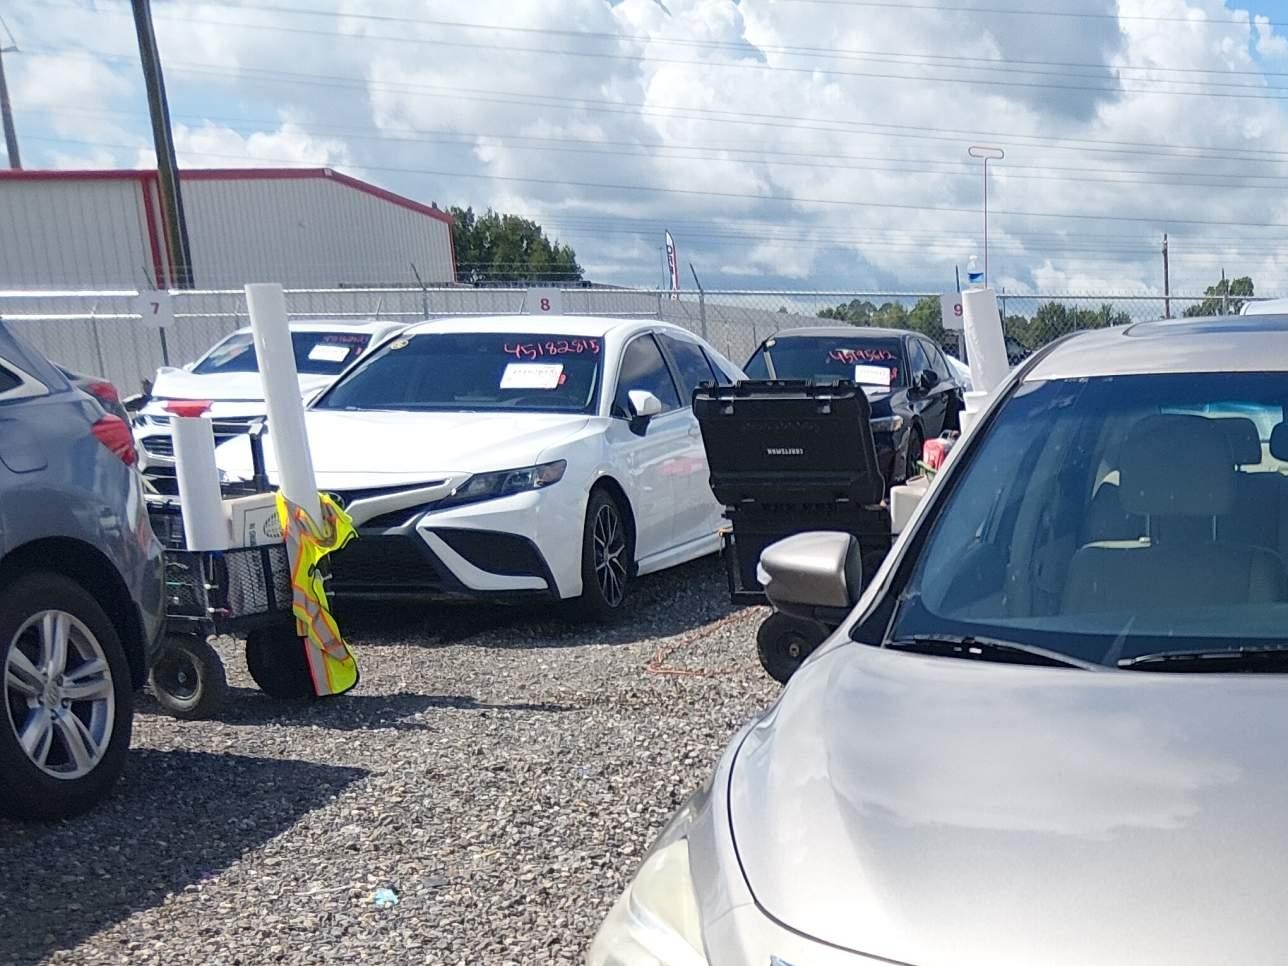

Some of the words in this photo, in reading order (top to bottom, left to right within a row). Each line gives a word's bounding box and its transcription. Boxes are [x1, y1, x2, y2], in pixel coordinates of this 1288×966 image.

[150, 301, 160, 315] 7
[540, 297, 551, 311] 8
[953, 303, 963, 317] 9
[503, 338, 600, 360] 45182815
